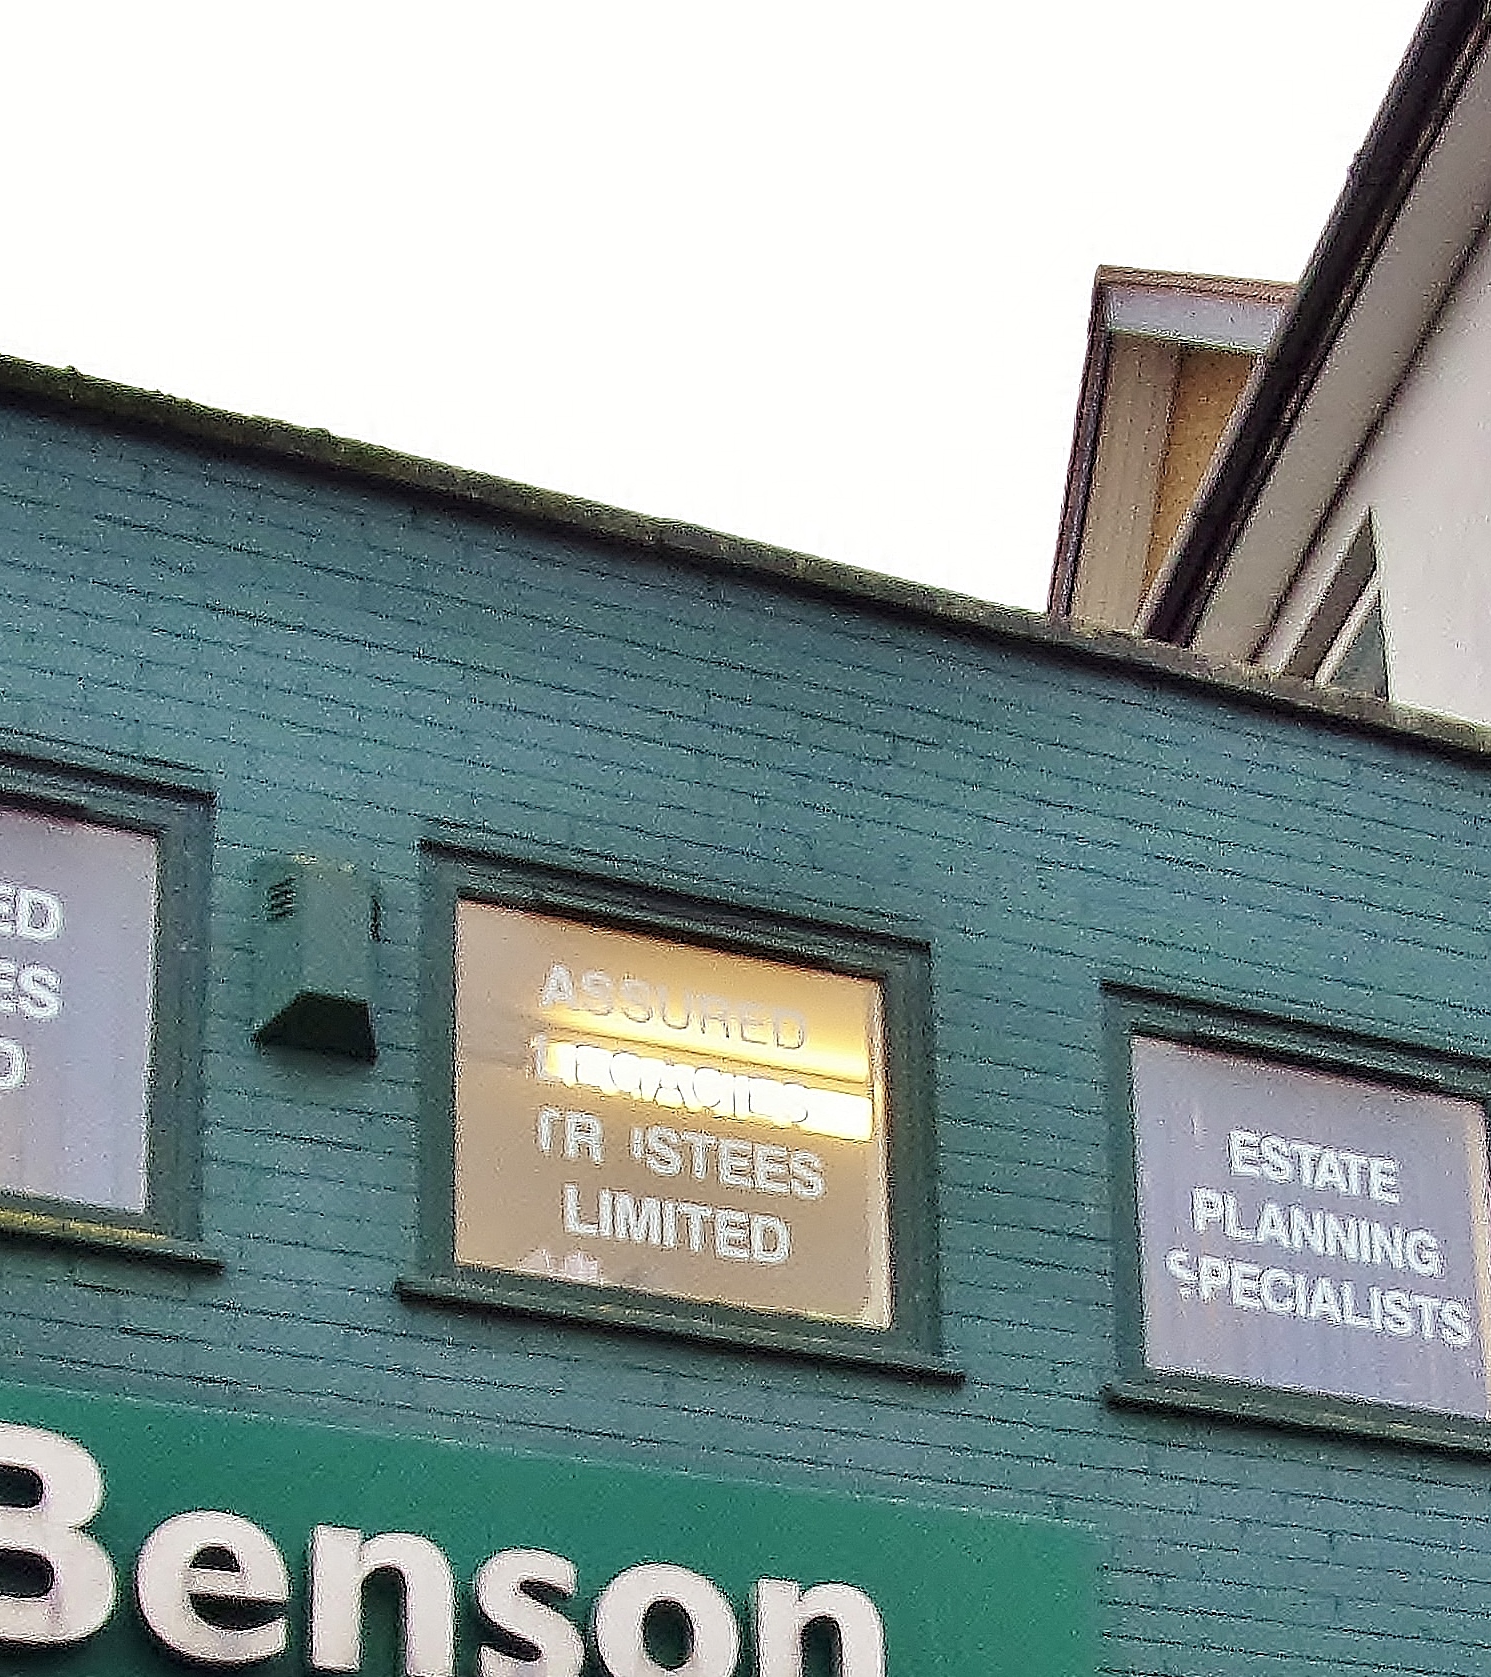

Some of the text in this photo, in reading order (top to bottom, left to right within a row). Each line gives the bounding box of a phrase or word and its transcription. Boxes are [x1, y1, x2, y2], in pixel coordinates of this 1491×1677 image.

[540, 962, 808, 1052] ASSURED
[1227, 1127, 1402, 1204] ESTATE
[564, 1183, 792, 1265] LIMITED
[1191, 1186, 1445, 1280] PLANNING
[1164, 1245, 1472, 1350] SPECIALISTS
